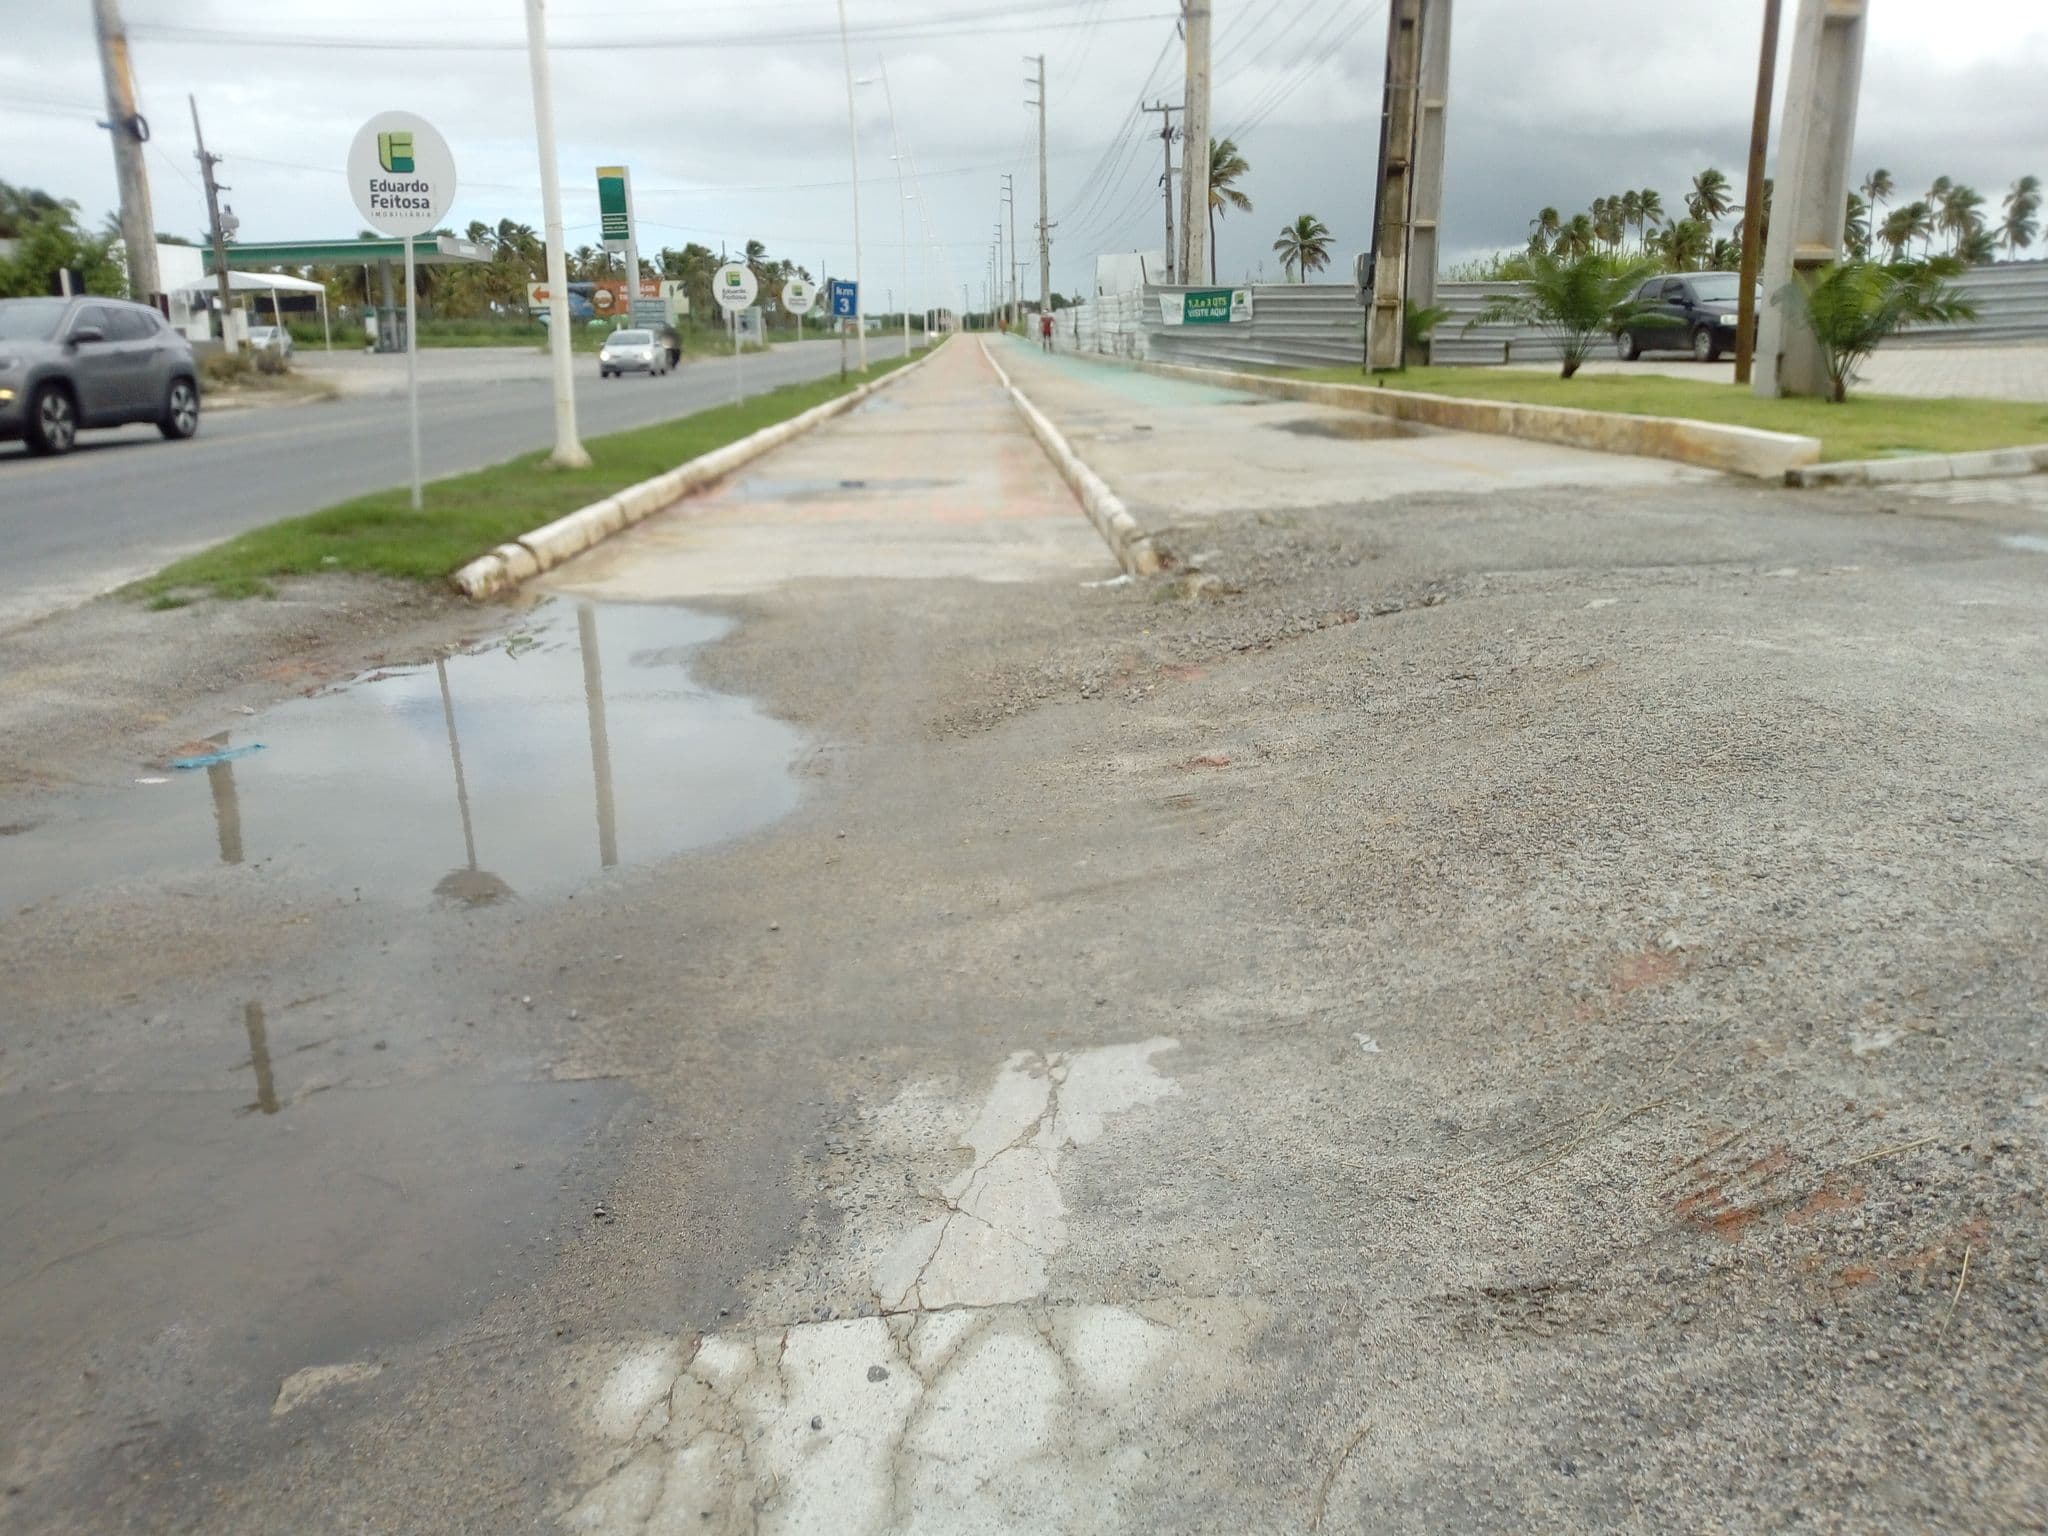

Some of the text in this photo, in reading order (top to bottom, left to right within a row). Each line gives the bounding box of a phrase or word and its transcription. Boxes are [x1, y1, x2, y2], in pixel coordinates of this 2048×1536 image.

[369, 179, 429, 192] Eduardo
[370, 194, 430, 209] Feitosa
[836, 287, 854, 296] km
[839, 298, 850, 313] 3
[1187, 308, 1209, 317] VISITE
[1210, 307, 1226, 316] AQUI
